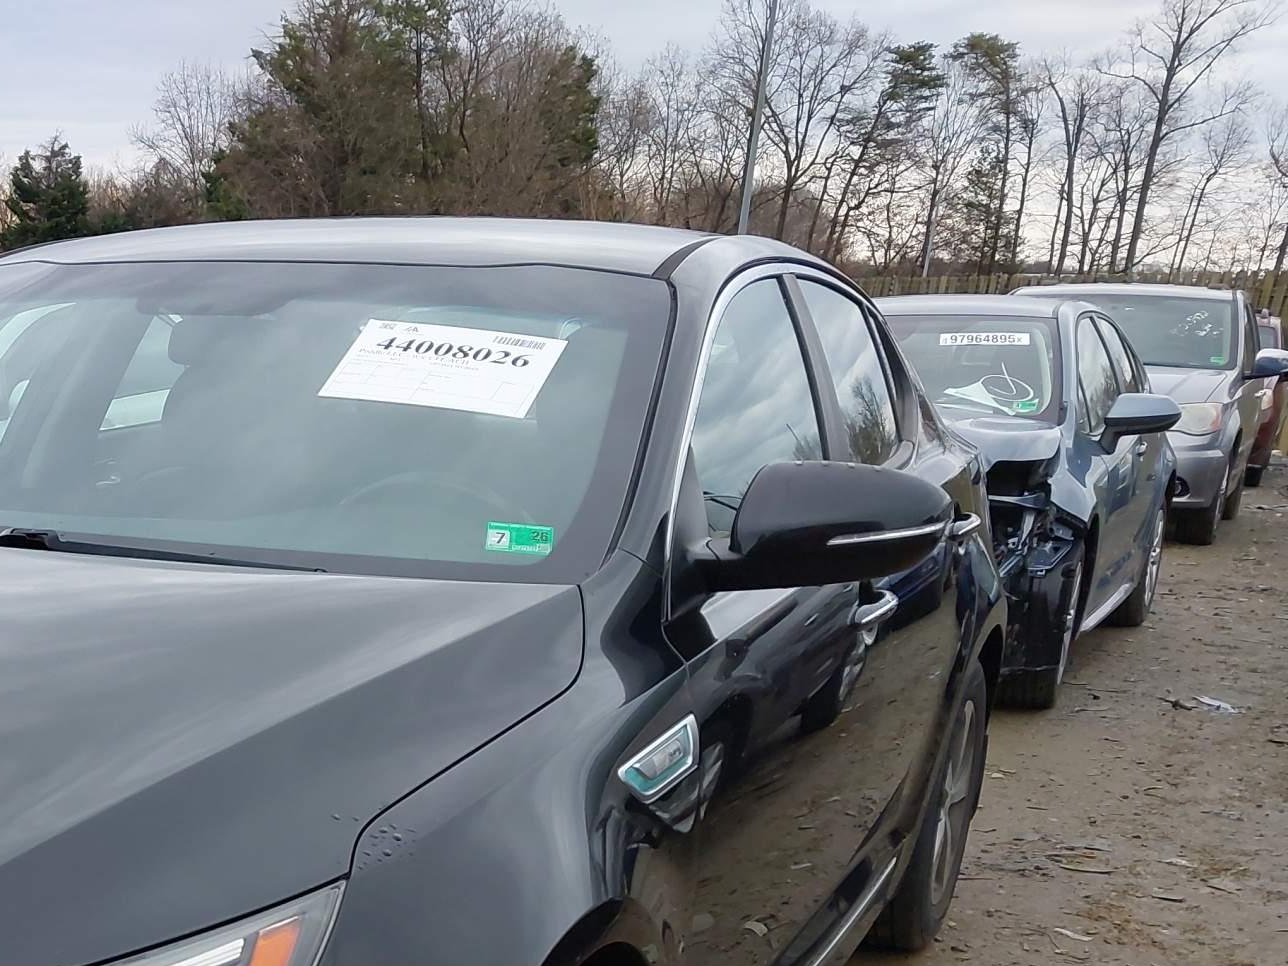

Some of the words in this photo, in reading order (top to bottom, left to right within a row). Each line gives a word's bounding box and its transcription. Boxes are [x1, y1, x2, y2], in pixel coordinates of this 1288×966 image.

[376, 336, 534, 368] 44008026
[495, 532, 506, 544] 7
[531, 531, 548, 543] 26
